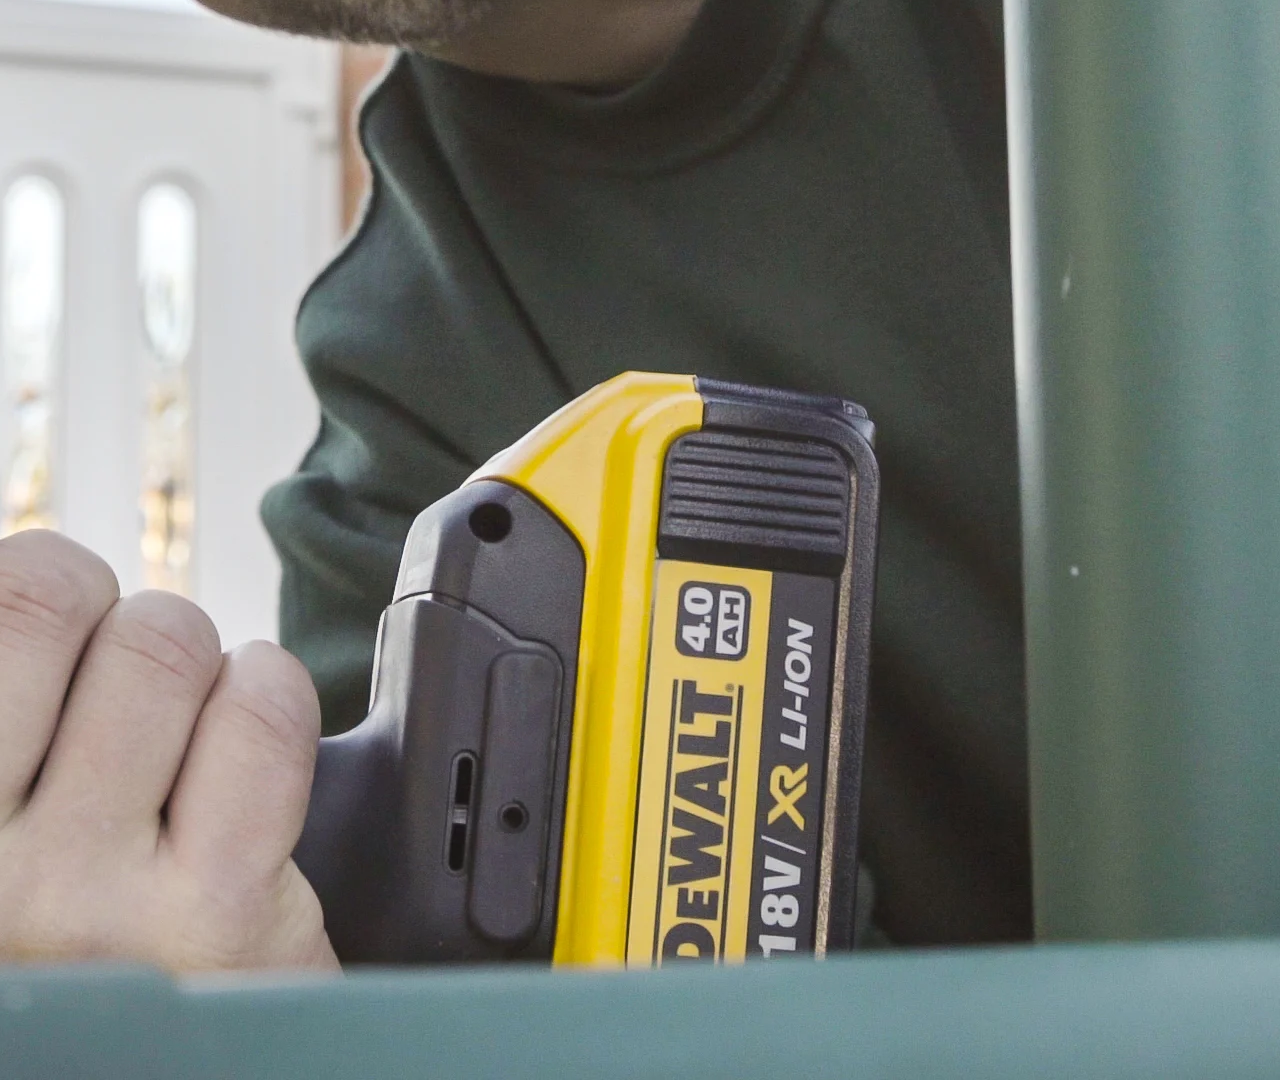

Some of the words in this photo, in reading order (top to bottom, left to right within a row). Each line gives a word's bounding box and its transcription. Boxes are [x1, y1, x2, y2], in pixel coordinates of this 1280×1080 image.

[682, 586, 714, 652] 4.0
[722, 596, 741, 650] AH
[780, 617, 814, 751] LI-ION
[661, 680, 734, 965] DEWALT
